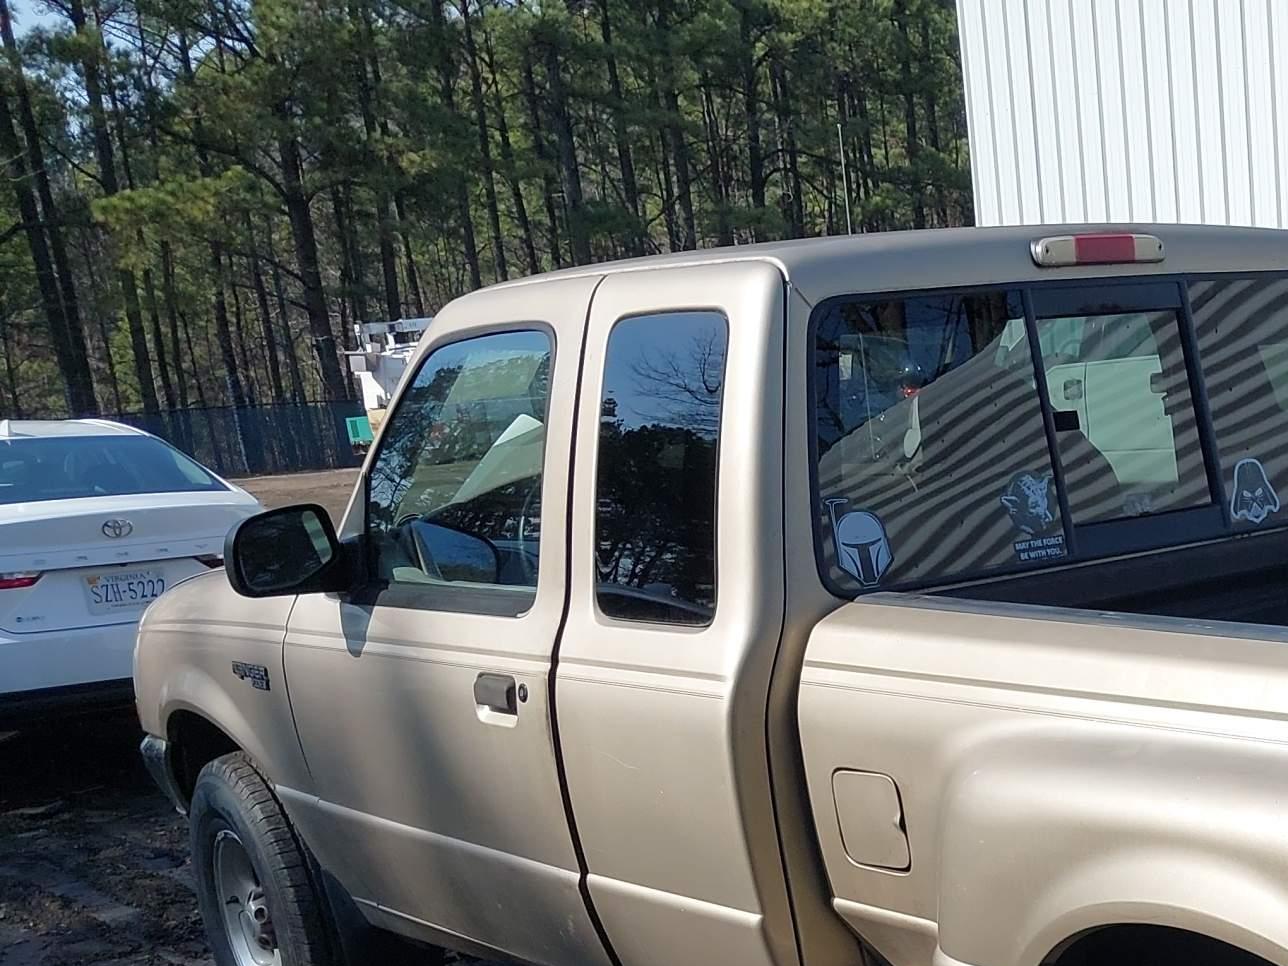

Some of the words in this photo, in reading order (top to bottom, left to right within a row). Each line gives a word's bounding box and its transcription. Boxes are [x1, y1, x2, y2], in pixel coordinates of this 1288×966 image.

[1015, 542, 1029, 550] MAY
[1031, 539, 1043, 548] THE
[1043, 536, 1063, 546] FORCE
[1029, 549, 1046, 558] WITH
